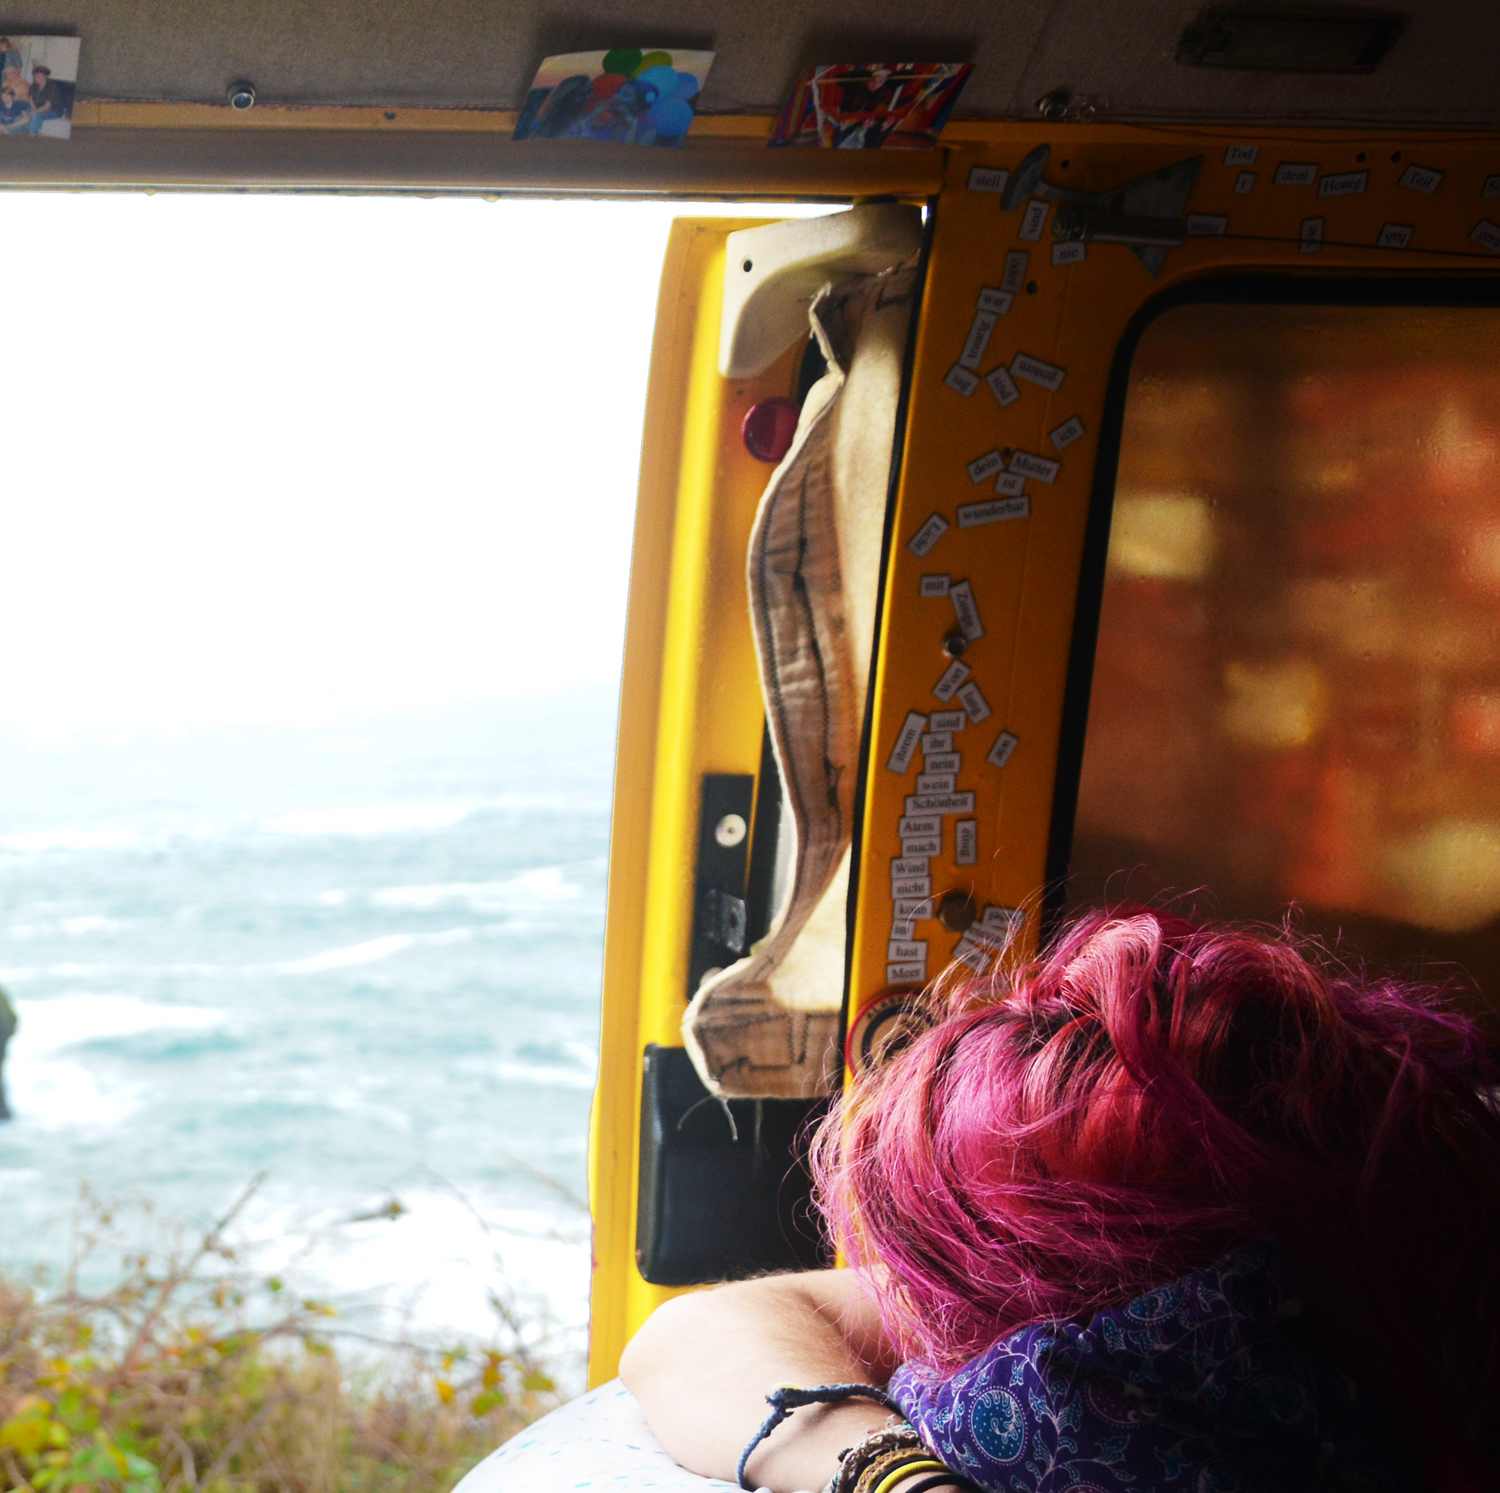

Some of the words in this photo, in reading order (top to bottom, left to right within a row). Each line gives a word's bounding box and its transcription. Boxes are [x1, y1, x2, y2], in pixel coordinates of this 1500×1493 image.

[1230, 147, 1253, 160] Tod
[976, 174, 1000, 187] stell
[1281, 168, 1308, 182] dem
[1323, 176, 1362, 193] Honig
[1408, 172, 1435, 188] Teil
[1029, 207, 1043, 234] sind
[1190, 221, 1221, 234] unter
[1384, 230, 1405, 245] hab
[1019, 360, 1057, 382] gestern
[994, 377, 1013, 399] sind
[1060, 425, 1077, 442] ich
[974, 457, 999, 476] dein
[1014, 456, 1052, 477] Mutter
[1002, 477, 1016, 489] ist
[963, 500, 1025, 521] wunderbar
[915, 522, 941, 550] Licht
[956, 590, 975, 628] Zunge
[940, 667, 965, 694] Wort
[964, 691, 982, 717] lang
[936, 716, 960, 728] sind
[896, 728, 917, 762] ihrem
[930, 738, 946, 749] ihr
[913, 795, 968, 810] Schönheit
[903, 821, 934, 833] Atem
[907, 840, 936, 853] mach
[896, 860, 926, 873] Wind
[896, 882, 925, 894] nicht
[896, 944, 918, 957] hast
[892, 966, 921, 978] Meer
